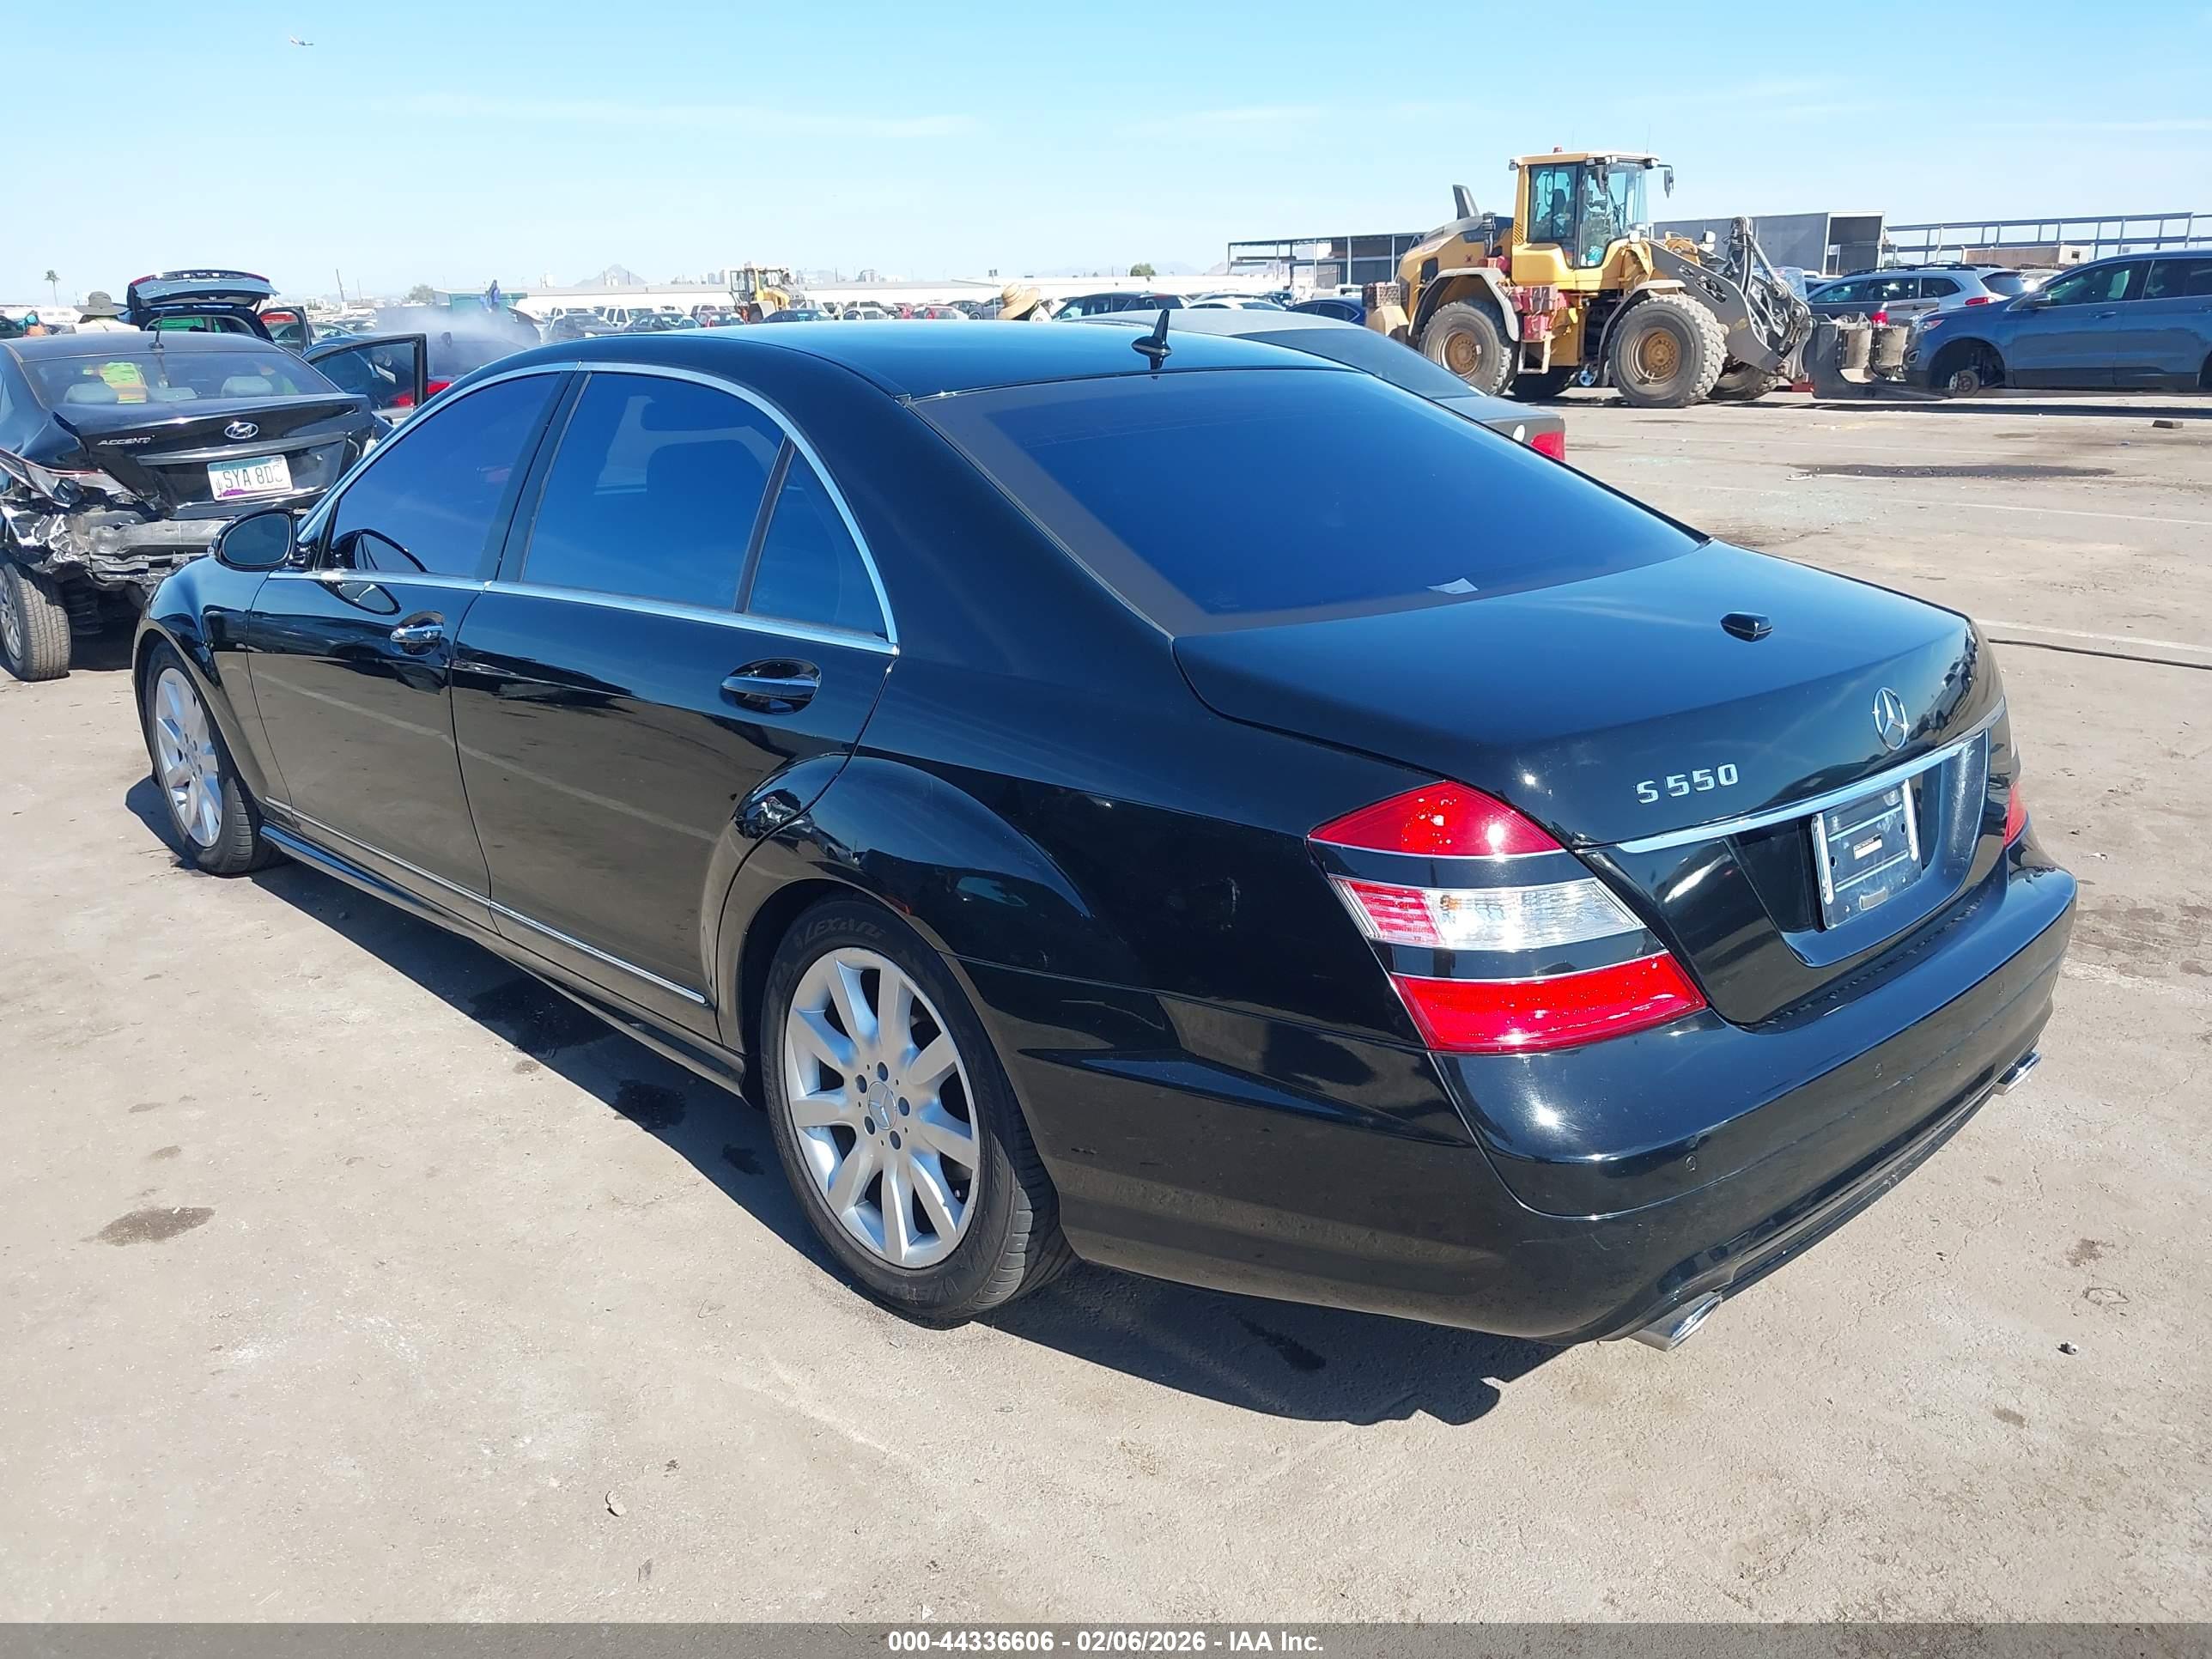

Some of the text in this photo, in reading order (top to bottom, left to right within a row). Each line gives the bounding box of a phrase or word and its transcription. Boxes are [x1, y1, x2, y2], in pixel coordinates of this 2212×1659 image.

[96, 436, 151, 447] ACCENT
[222, 468, 252, 489] SYA
[1635, 763, 1739, 805] S 550
